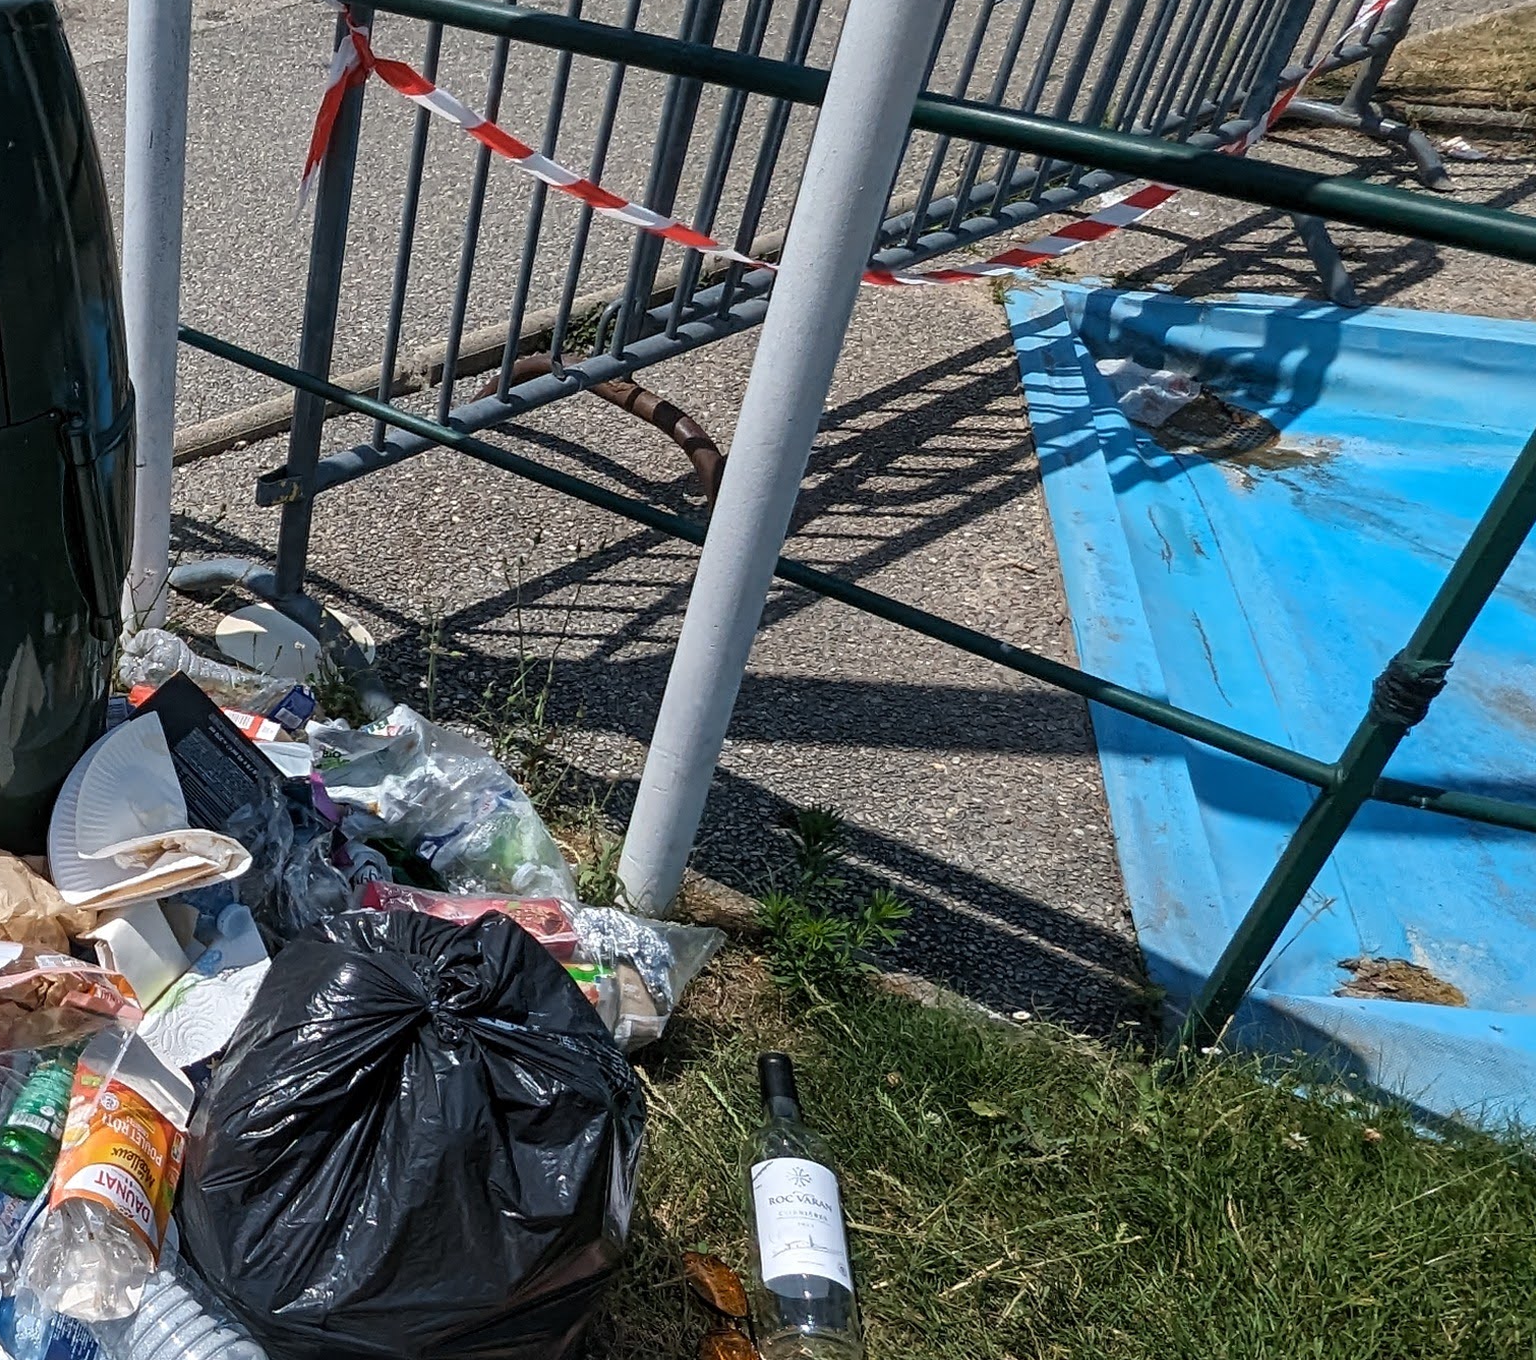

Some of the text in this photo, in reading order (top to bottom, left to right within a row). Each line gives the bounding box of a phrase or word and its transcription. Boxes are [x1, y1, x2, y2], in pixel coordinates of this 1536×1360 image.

[130, 1130, 162, 1166] POULET
[94, 1170, 151, 1223] DAUNAT
[769, 1191, 832, 1213] ROC VARAN
